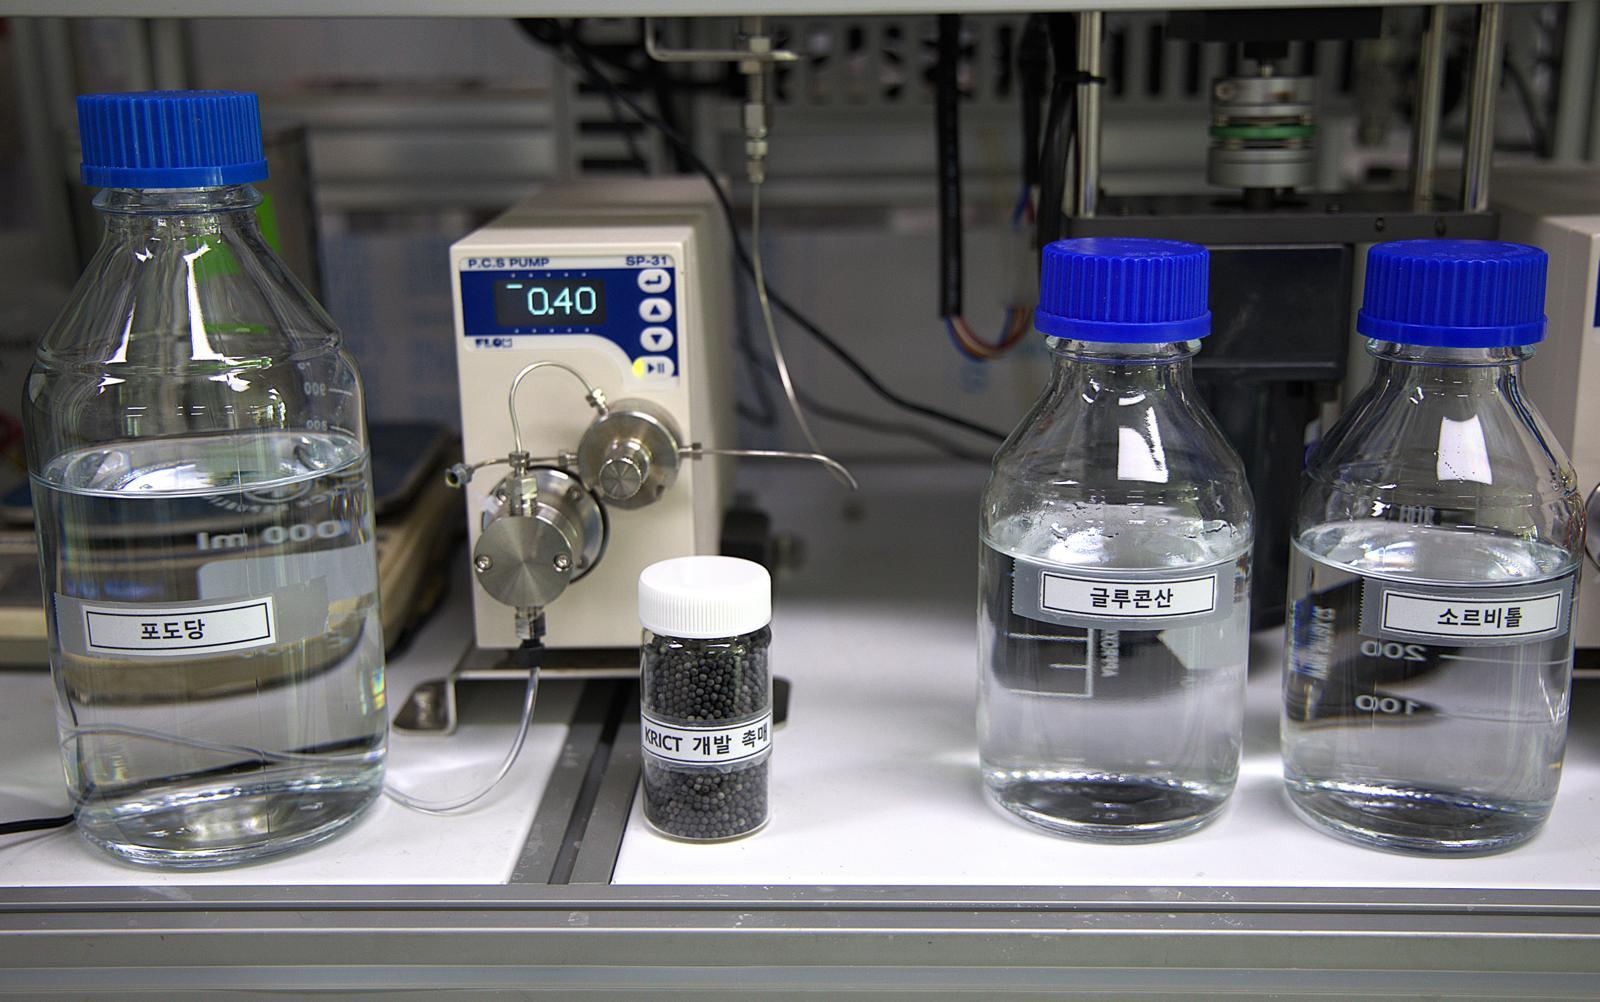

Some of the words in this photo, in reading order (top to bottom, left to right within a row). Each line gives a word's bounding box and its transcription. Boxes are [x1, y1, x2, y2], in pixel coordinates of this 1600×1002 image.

[468, 257, 505, 268] P.C.S
[509, 257, 550, 267] PUMP
[625, 255, 668, 266] SP-31
[1089, 588, 1174, 610] 글루콘산
[1437, 606, 1523, 629] 소르비톨
[140, 618, 206, 641] 포도당
[644, 725, 683, 753] KRICT
[692, 734, 732, 756] 개발
[741, 722, 768, 748] 촉매
